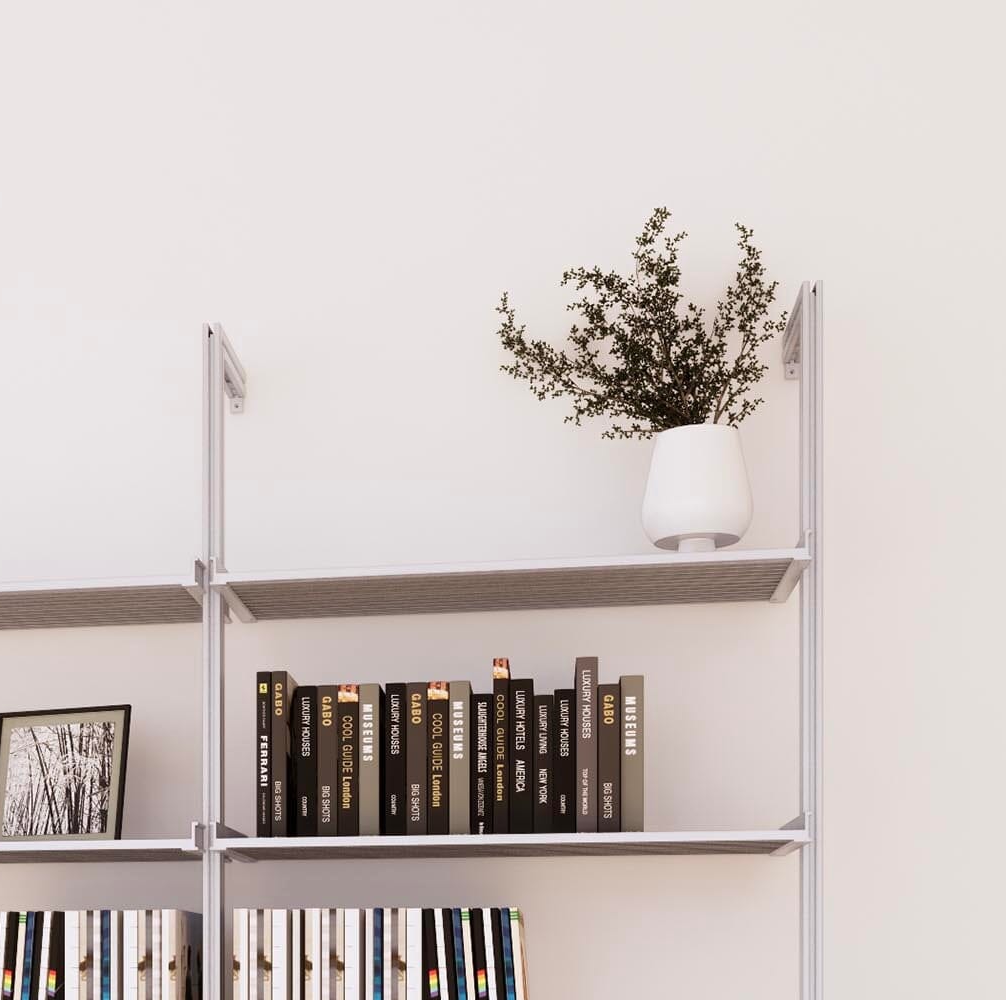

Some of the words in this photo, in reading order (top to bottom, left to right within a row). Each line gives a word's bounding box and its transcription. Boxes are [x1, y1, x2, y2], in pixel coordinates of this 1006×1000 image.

[582, 670, 592, 702] LUXURY
[301, 697, 310, 726] LUXURY
[322, 696, 332, 726] GABO
[391, 695, 400, 724] LUXURY
[411, 693, 422, 724] GABO
[496, 694, 504, 724] COOL
[516, 690, 525, 720] LUXURY
[539, 705, 547, 732] LUXURY
[560, 700, 568, 726] LUXURY
[604, 695, 614, 724] GABO
[342, 716, 352, 741] COOL
[363, 704, 373, 762] MUSEUMS
[432, 713, 442, 739] COOL
[453, 701, 464, 760] MUSEUMS
[516, 721, 525, 750] HOTELS
[582, 705, 592, 738] HOUSES
[626, 696, 636, 756] MUSEUMS
[301, 727, 310, 756] HOUSES
[391, 724, 400, 754] HOUSES
[496, 728, 504, 760] GUIDE
[539, 733, 547, 754] LIVING
[560, 728, 568, 757] HOUSES
[260, 736, 268, 787] FERRARI
[342, 744, 352, 773] GUIDE
[432, 742, 442, 771] GUIDE
[478, 752, 487, 773] ANGELS
[411, 784, 420, 796] BIG
[496, 764, 504, 801] London
[516, 760, 525, 792] AMERICA
[539, 769, 547, 784] NEW
[604, 783, 612, 794] BIG
[322, 786, 330, 798] BIG
[342, 776, 352, 809] London
[432, 775, 442, 807] London
[539, 785, 547, 804] YORK
[322, 799, 330, 823] SHOTS
[411, 798, 420, 822] SHOTS
[604, 796, 612, 818] SHOTS
